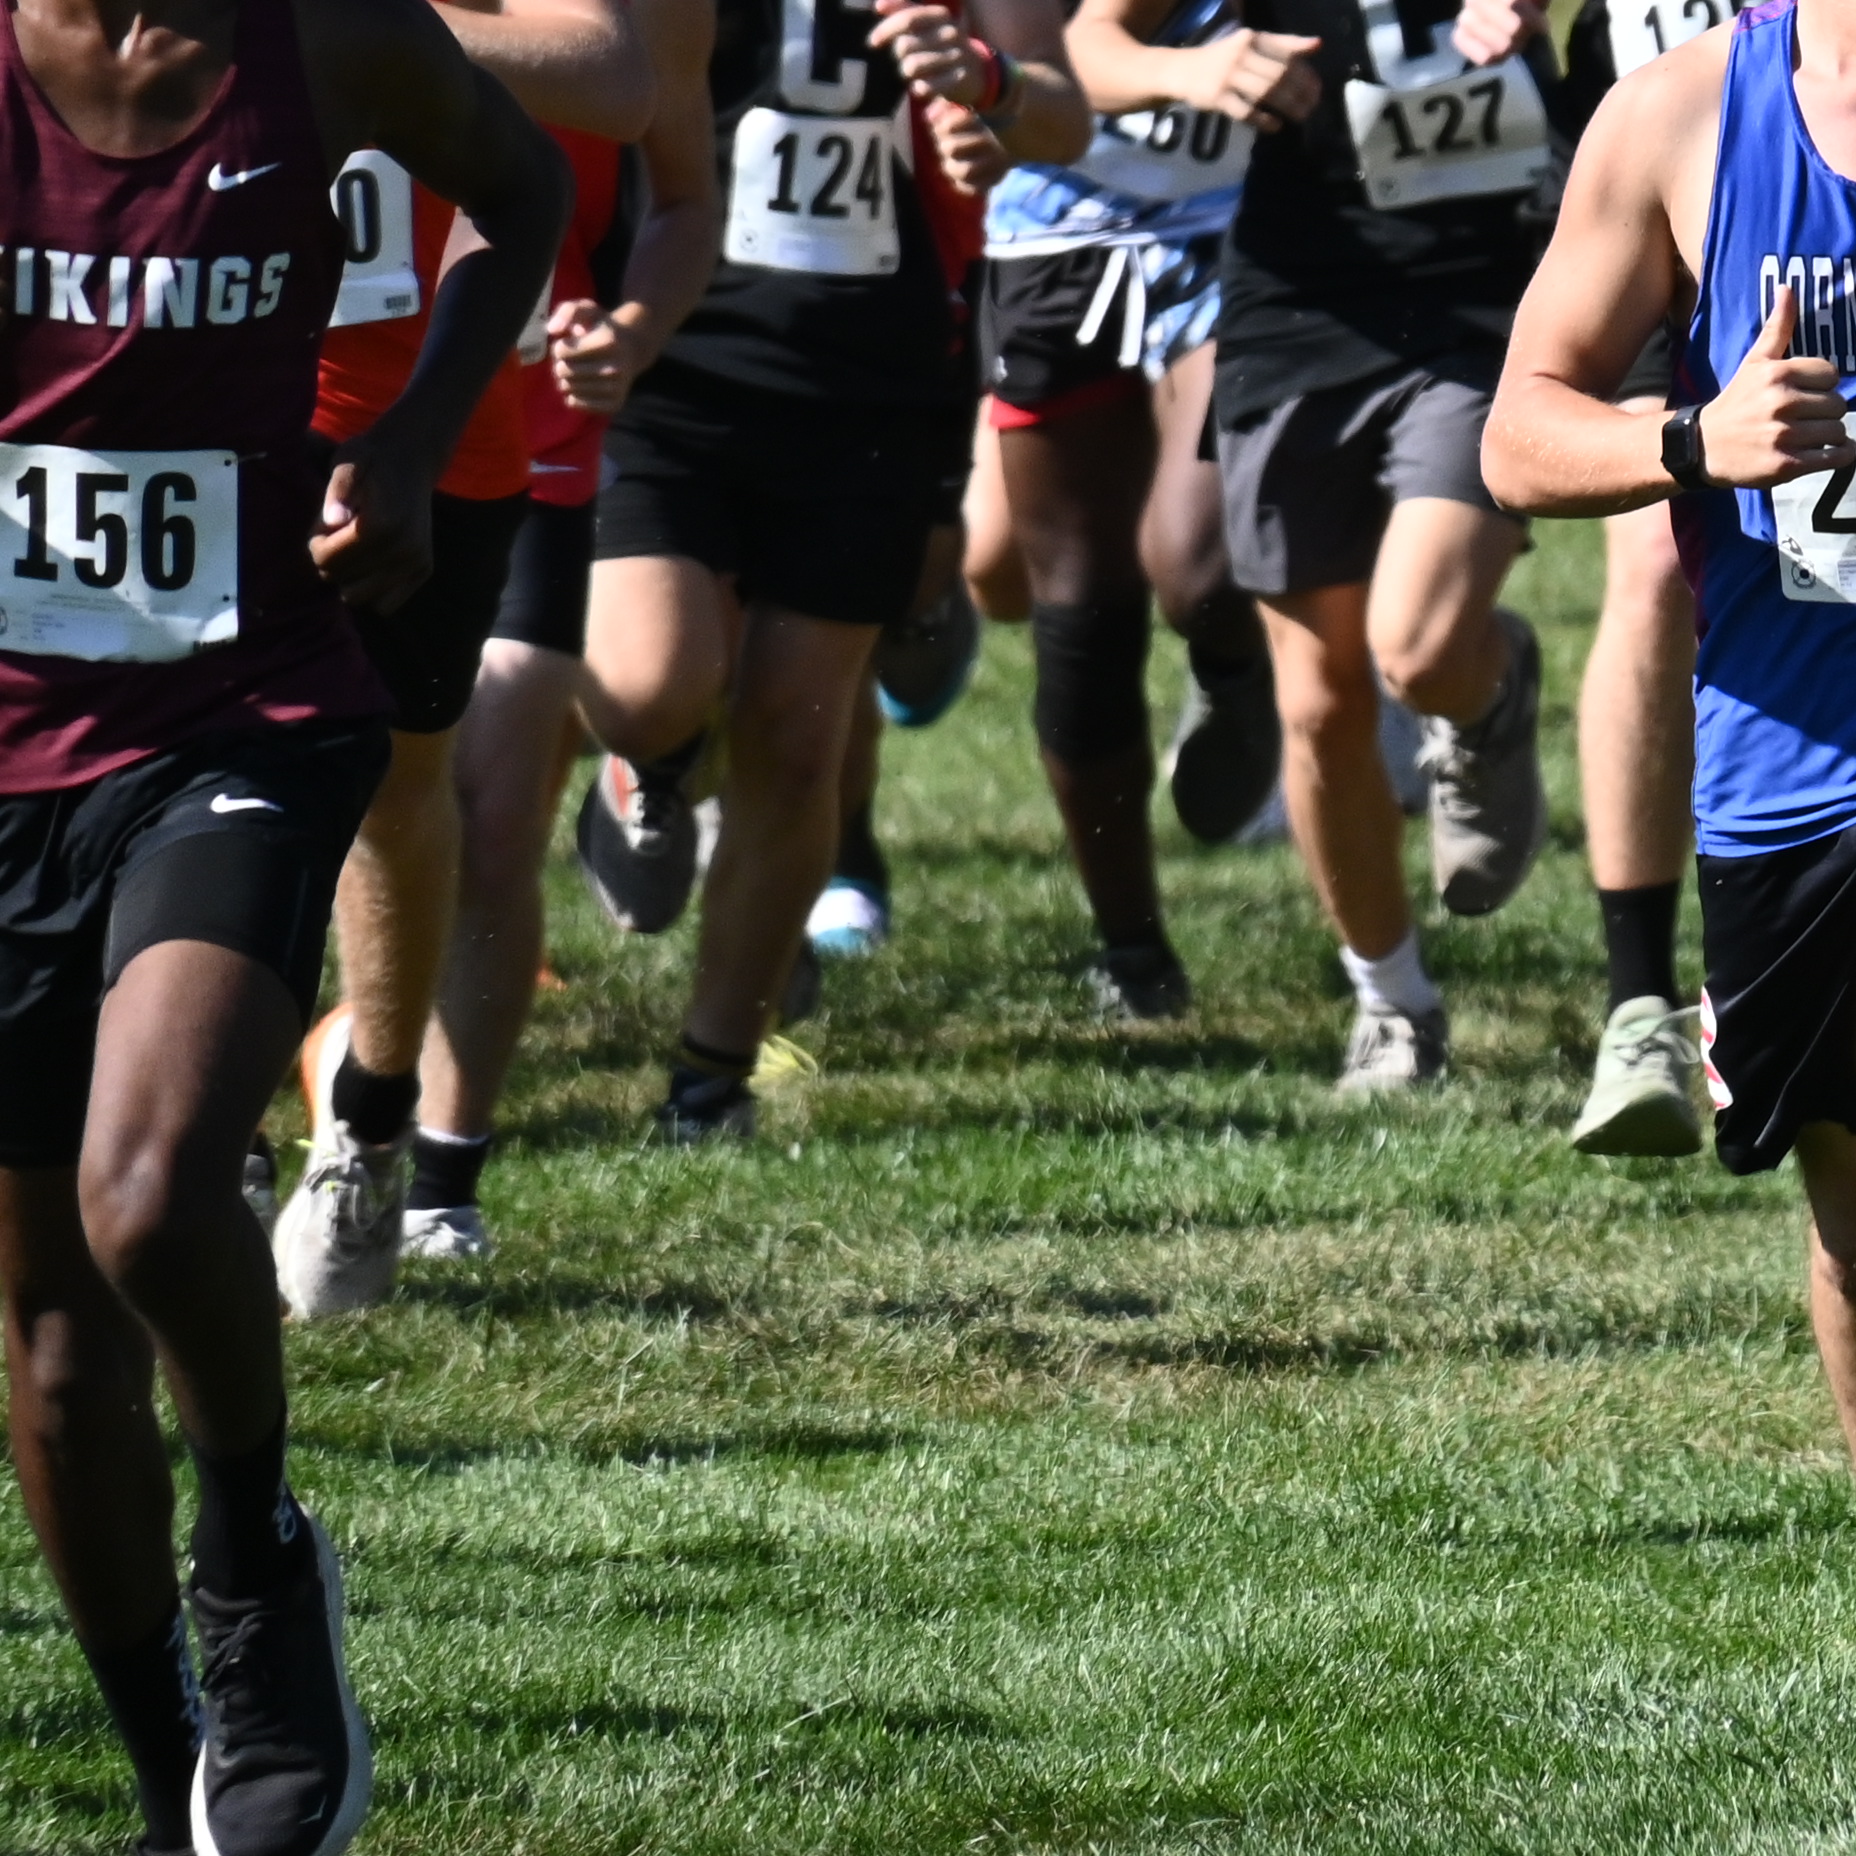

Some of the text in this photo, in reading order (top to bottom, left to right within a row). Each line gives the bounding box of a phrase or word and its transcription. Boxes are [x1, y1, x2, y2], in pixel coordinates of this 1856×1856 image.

[1382, 76, 1504, 160] 127
[767, 133, 883, 220] 124
[0, 246, 290, 328] IKINGS
[14, 466, 197, 591] 156
